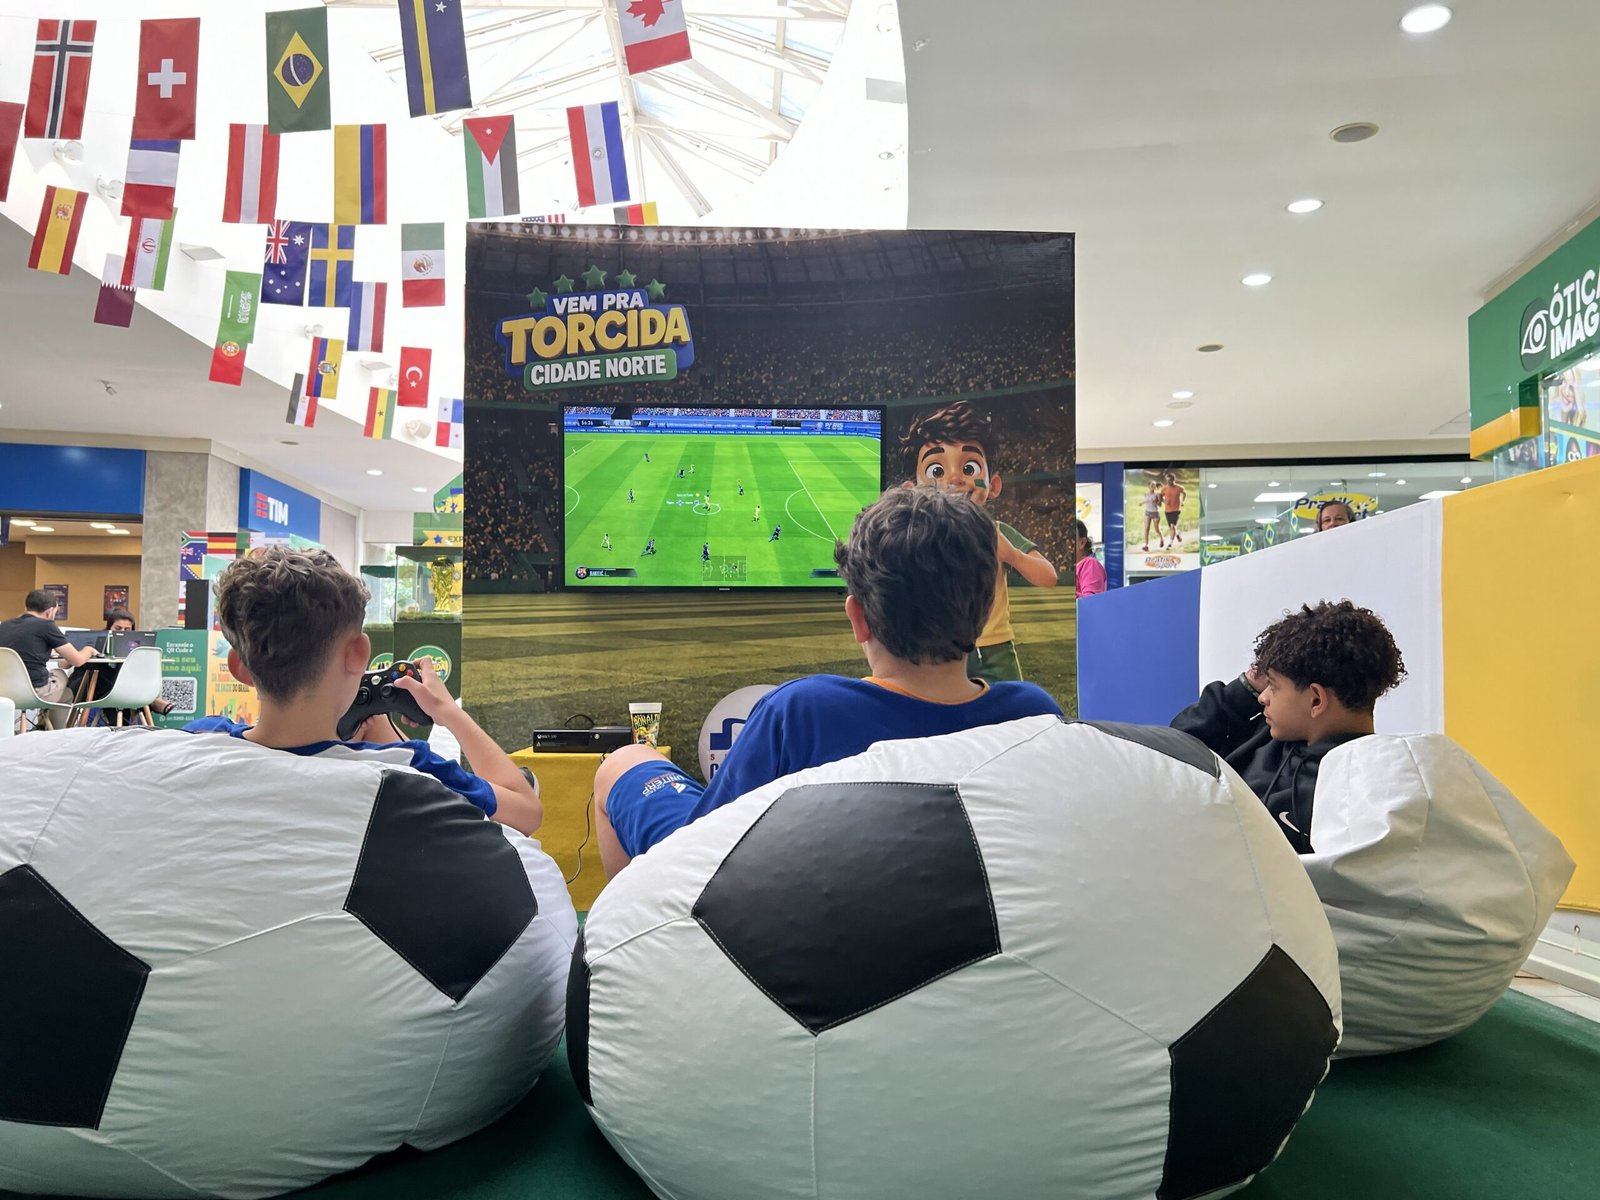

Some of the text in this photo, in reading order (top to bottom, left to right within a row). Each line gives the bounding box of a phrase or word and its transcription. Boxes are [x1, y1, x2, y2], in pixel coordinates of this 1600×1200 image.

[553, 291, 644, 315] VEM PRA
[502, 307, 691, 364] TORCIDA
[530, 354, 667, 386] CIDADE NORTE
[267, 496, 289, 526] TIM
